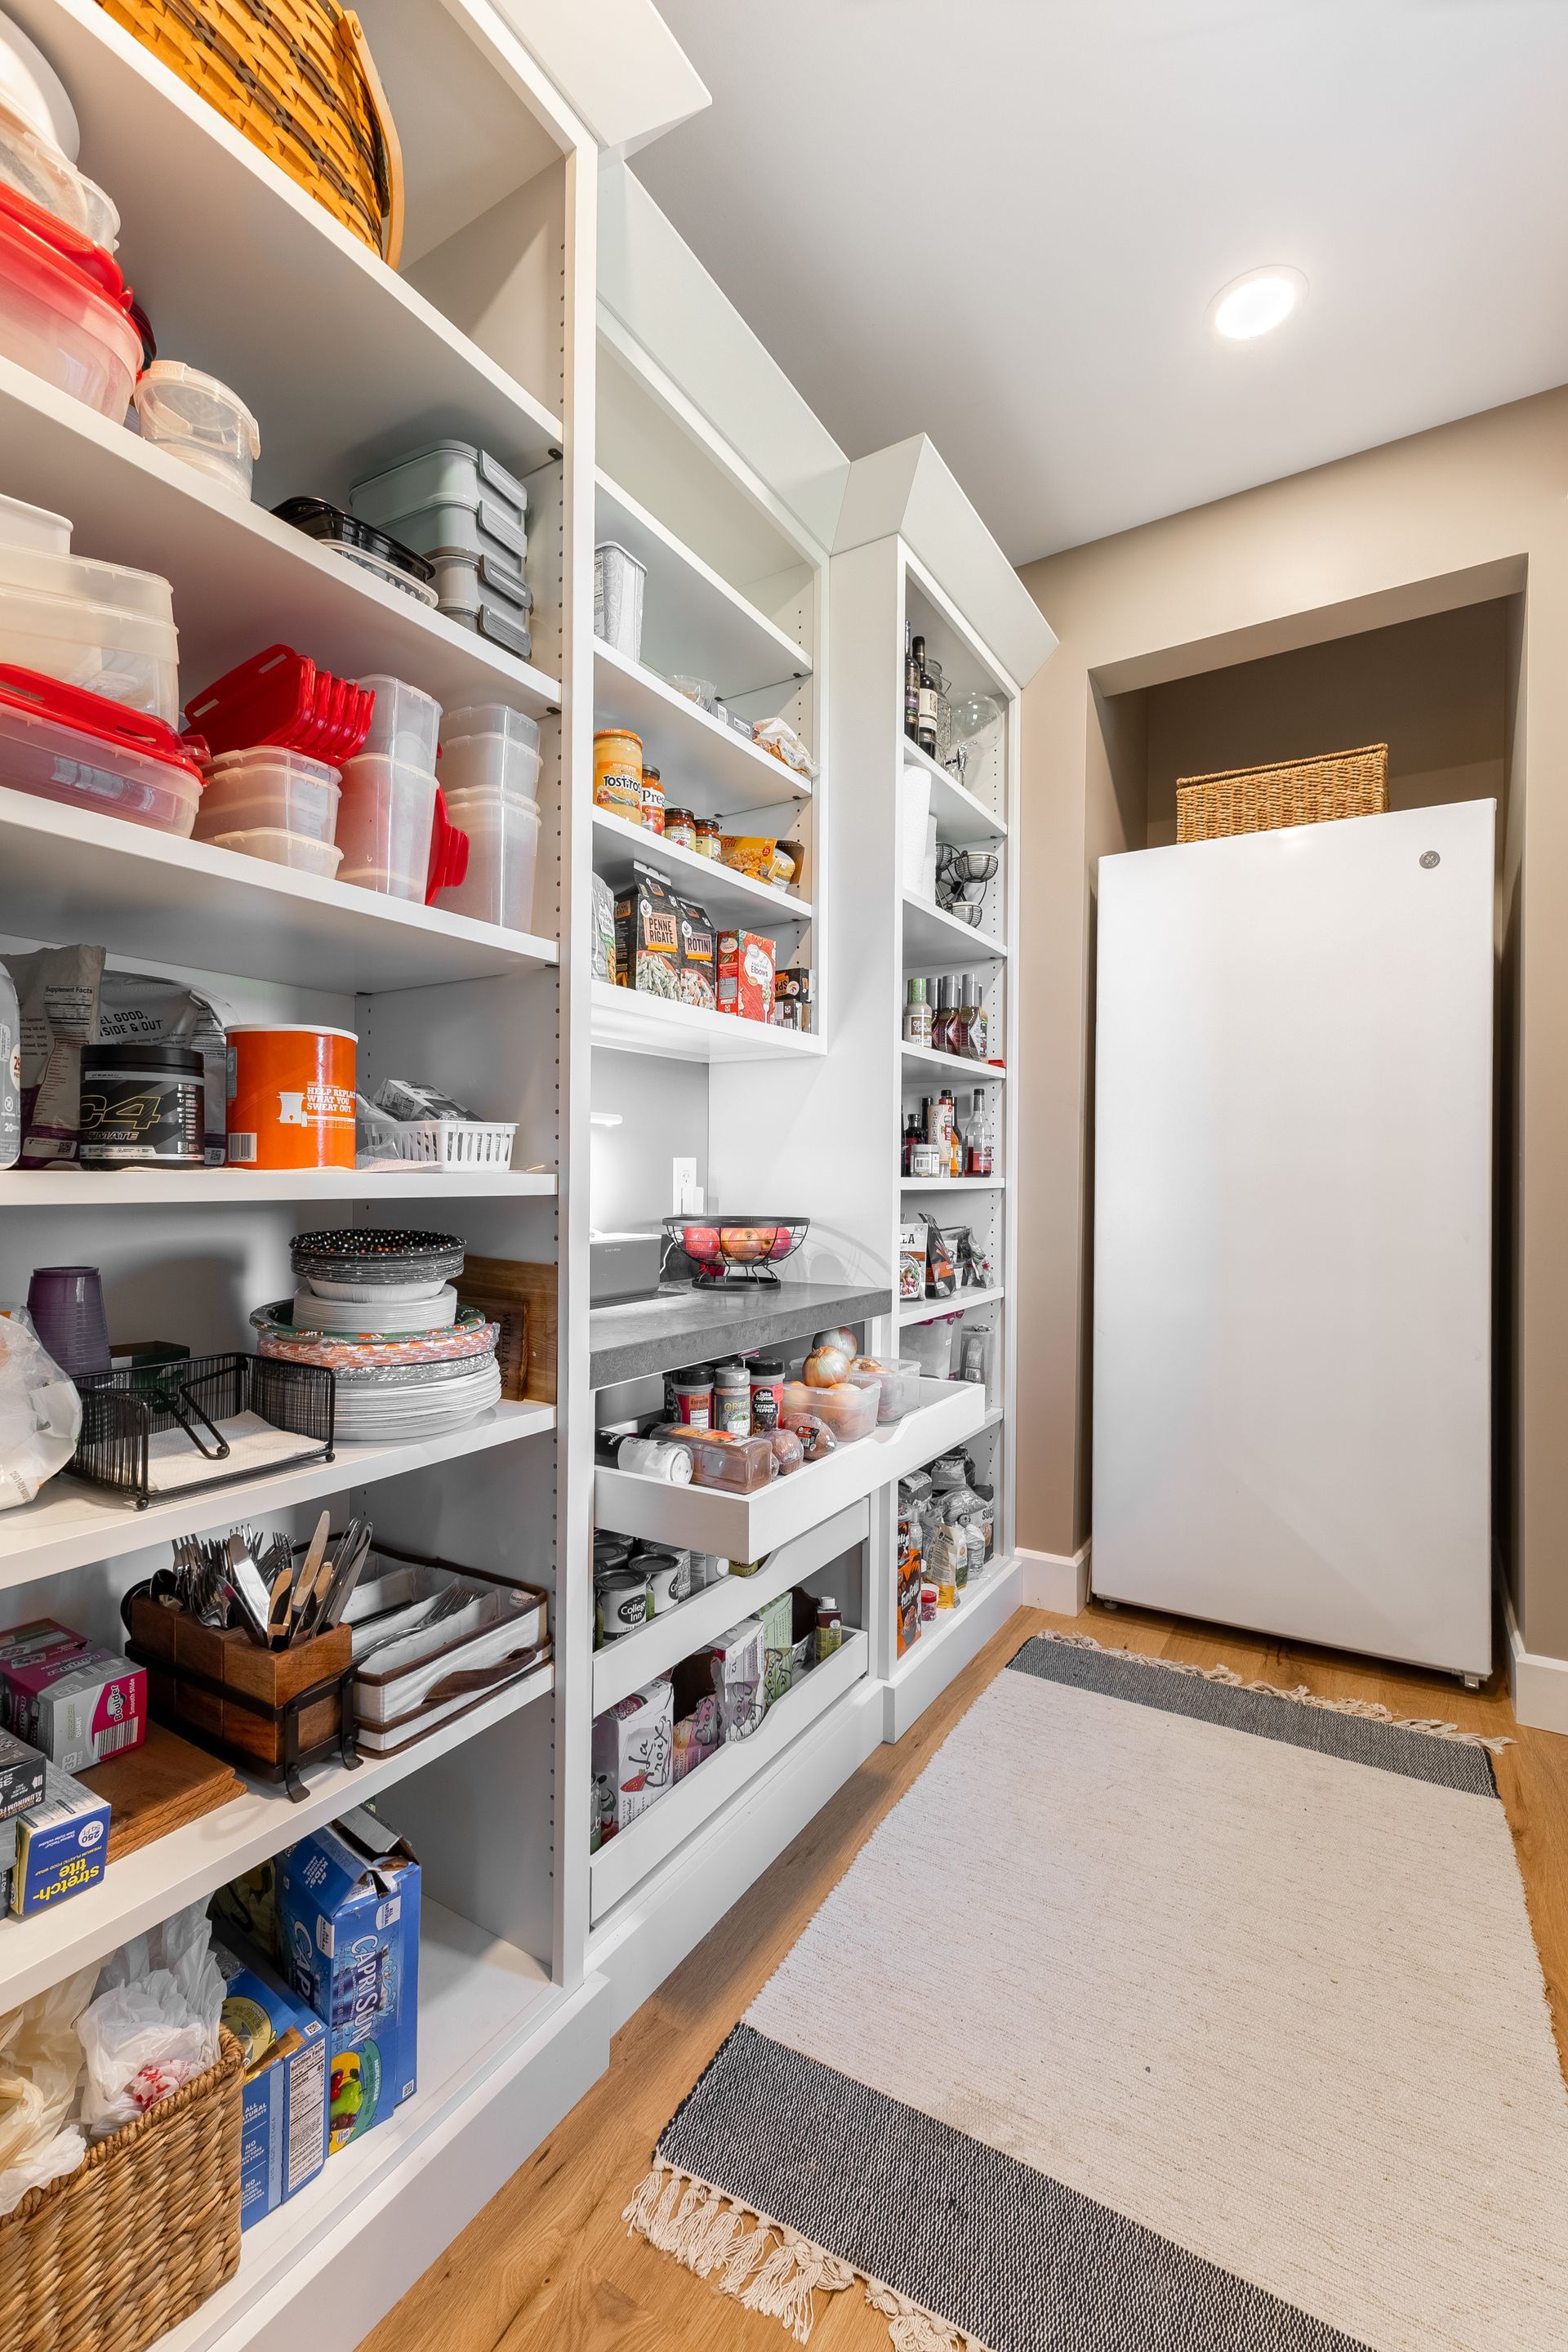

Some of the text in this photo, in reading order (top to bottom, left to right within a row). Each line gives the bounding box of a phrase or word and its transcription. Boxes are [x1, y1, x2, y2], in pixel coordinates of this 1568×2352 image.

[649, 918, 672, 930] PENNE
[649, 931, 675, 945] RIGATE
[688, 937, 711, 954] ROTINI
[46, 985, 93, 995] Supplement Facts
[114, 1010, 148, 1022] GOOD,
[130, 1022, 139, 1032] &
[141, 1020, 163, 1031] OUT
[307, 1087, 332, 1097] HELP
[307, 1095, 350, 1105] WHAT YOU
[307, 1102, 339, 1111] SWEAT
[501, 1312, 510, 1388] WILLIAMS
[630, 1611, 642, 1622] Inn
[114, 1684, 123, 1722] Boulder
[628, 1740, 653, 1770] La
[645, 1715, 671, 1787] Croix
[65, 1753, 75, 1771] 35
[7, 1790, 42, 1811] ALUMINUM
[81, 1830, 100, 1843] 250
[35, 1845, 102, 1876] PREMIUM PLASTIC FOOD WRAP
[59, 1859, 87, 1878] tite
[33, 1865, 100, 1900] stretch-
[372, 2059, 381, 2102] PACIFIC COOLER
[245, 2103, 258, 2114] ALL
[245, 2140, 256, 2151] NO
[245, 2178, 256, 2189] NO
